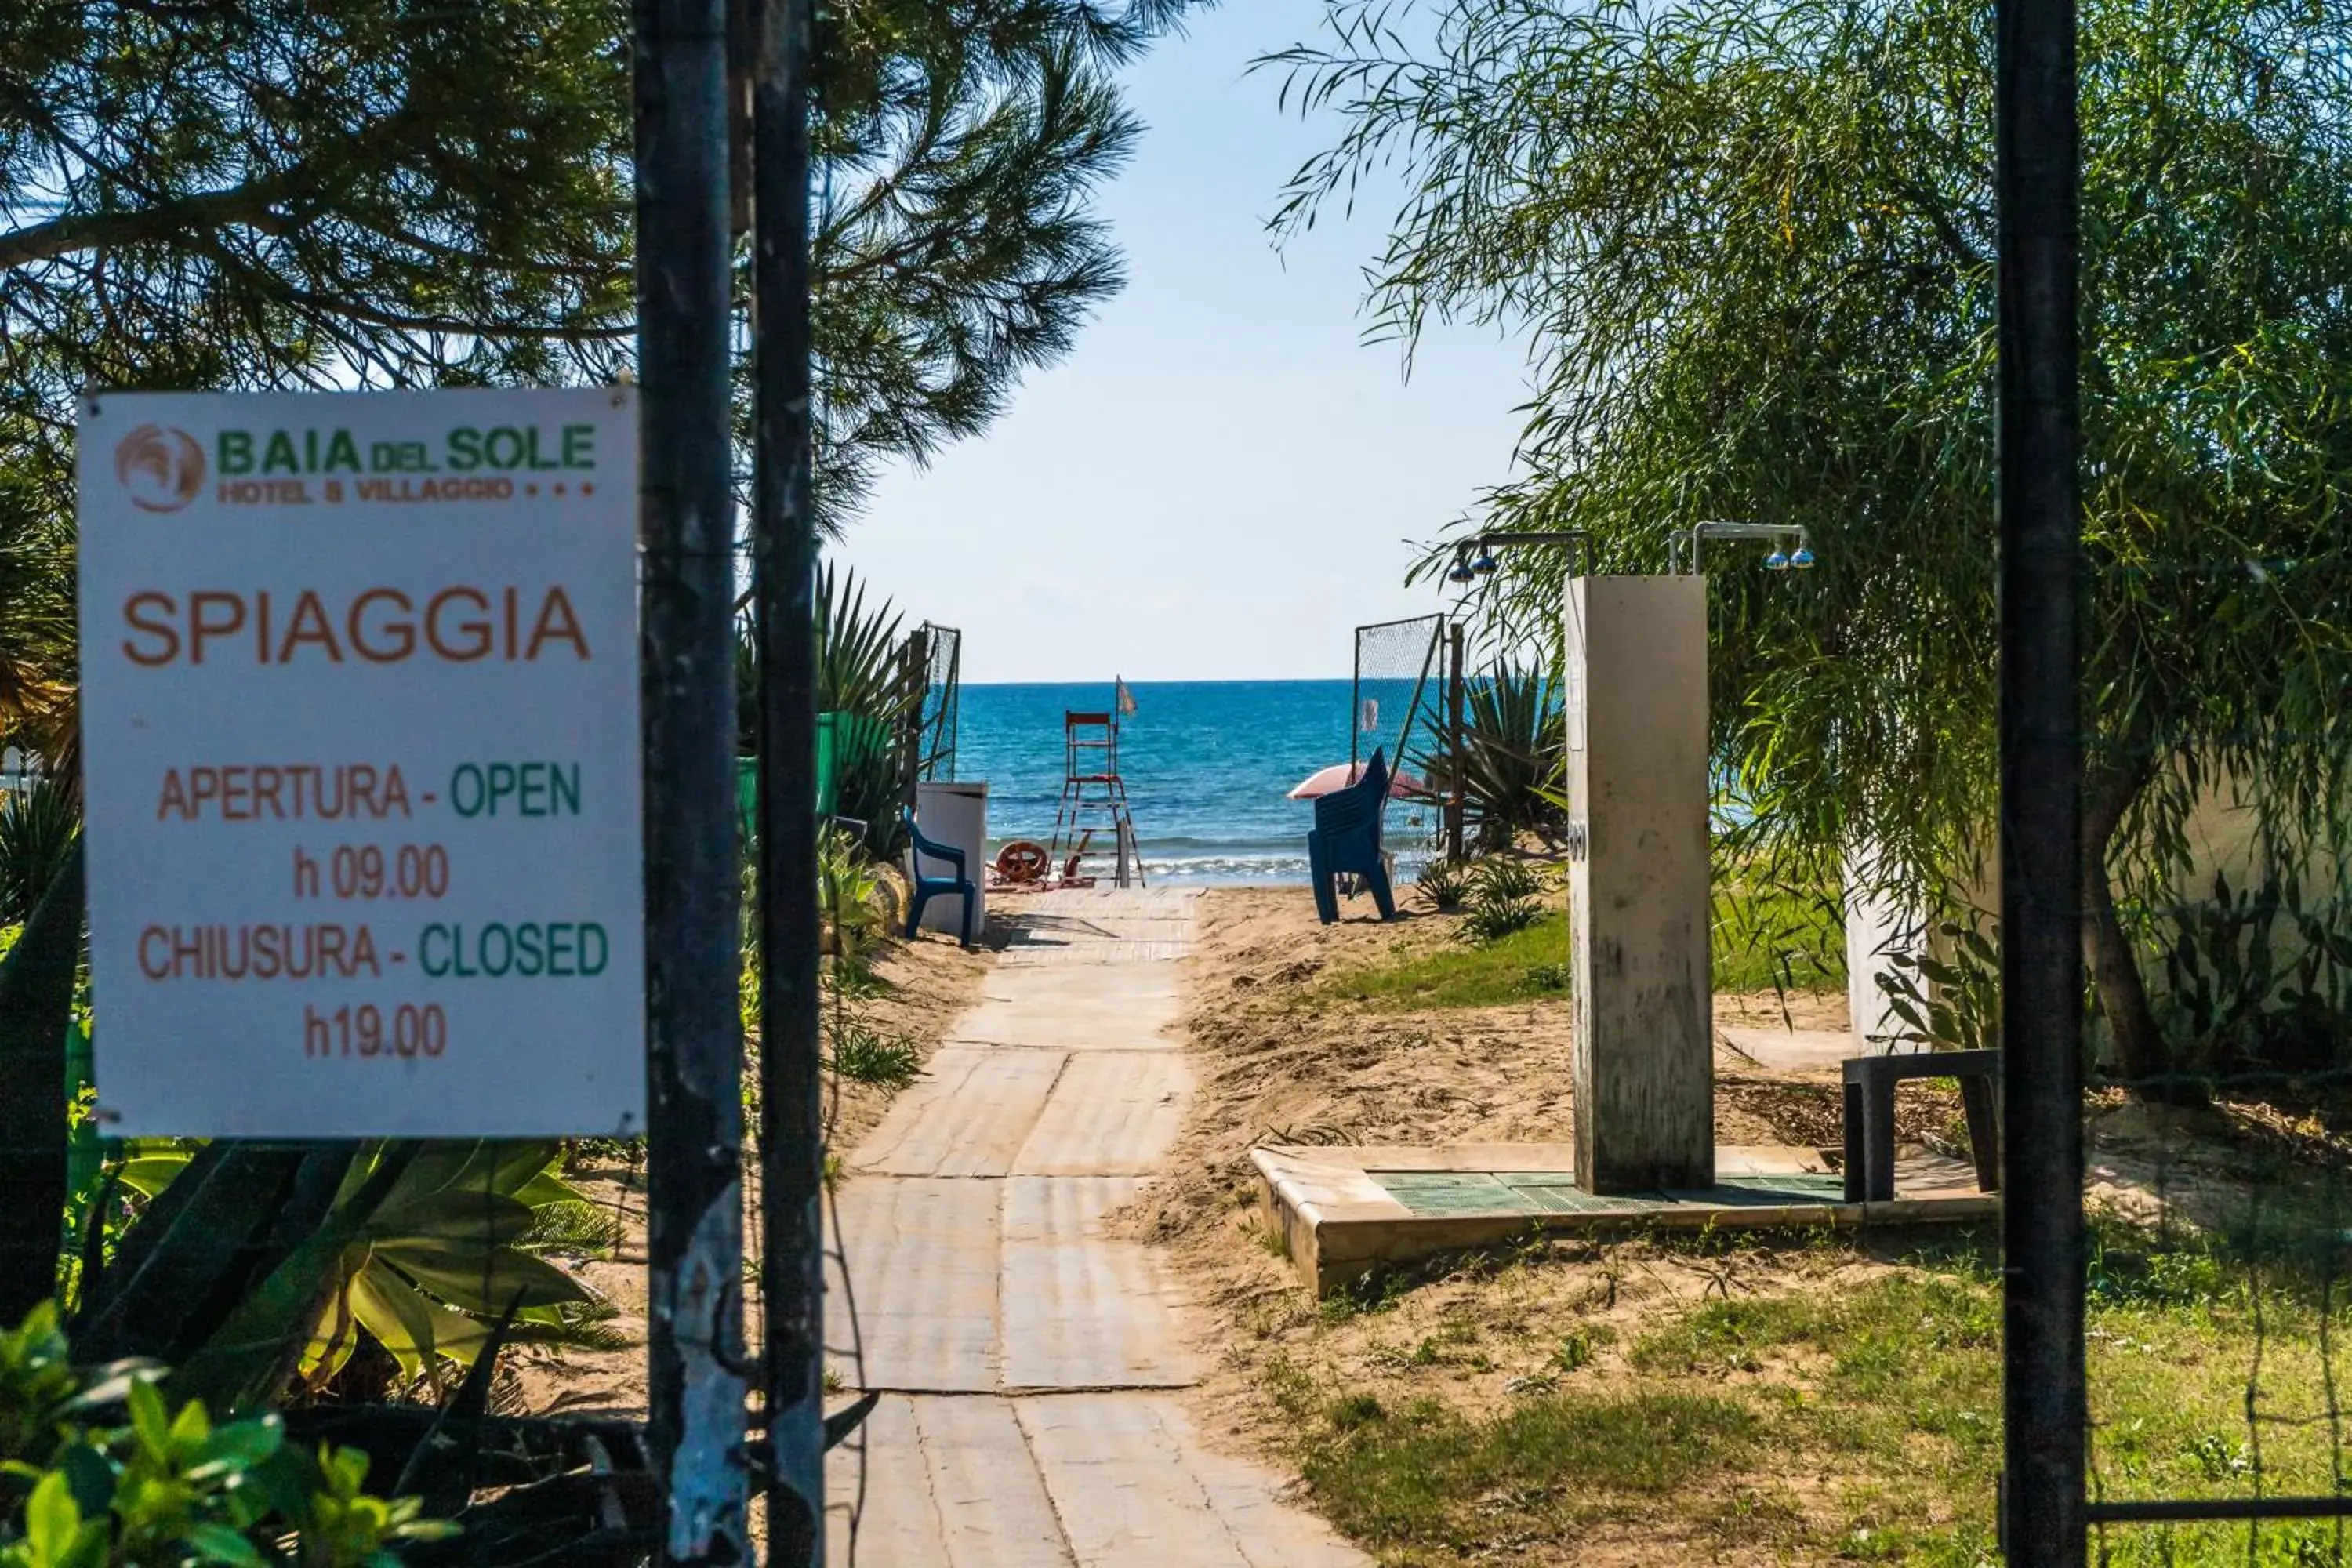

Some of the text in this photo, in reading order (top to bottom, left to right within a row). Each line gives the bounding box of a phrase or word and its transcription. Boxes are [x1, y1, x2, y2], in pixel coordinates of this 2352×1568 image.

[217, 424, 596, 475] BAIA DEL SOLE
[217, 479, 312, 504] HOTEL
[358, 477, 514, 503] VILLAGGIO
[122, 585, 591, 669] SPIAGGIA
[157, 764, 412, 822] APERTURA
[450, 761, 582, 818] OPEN
[332, 844, 449, 900] 09.00
[137, 924, 381, 982] CHIUSURA
[418, 921, 609, 978] CLOSED
